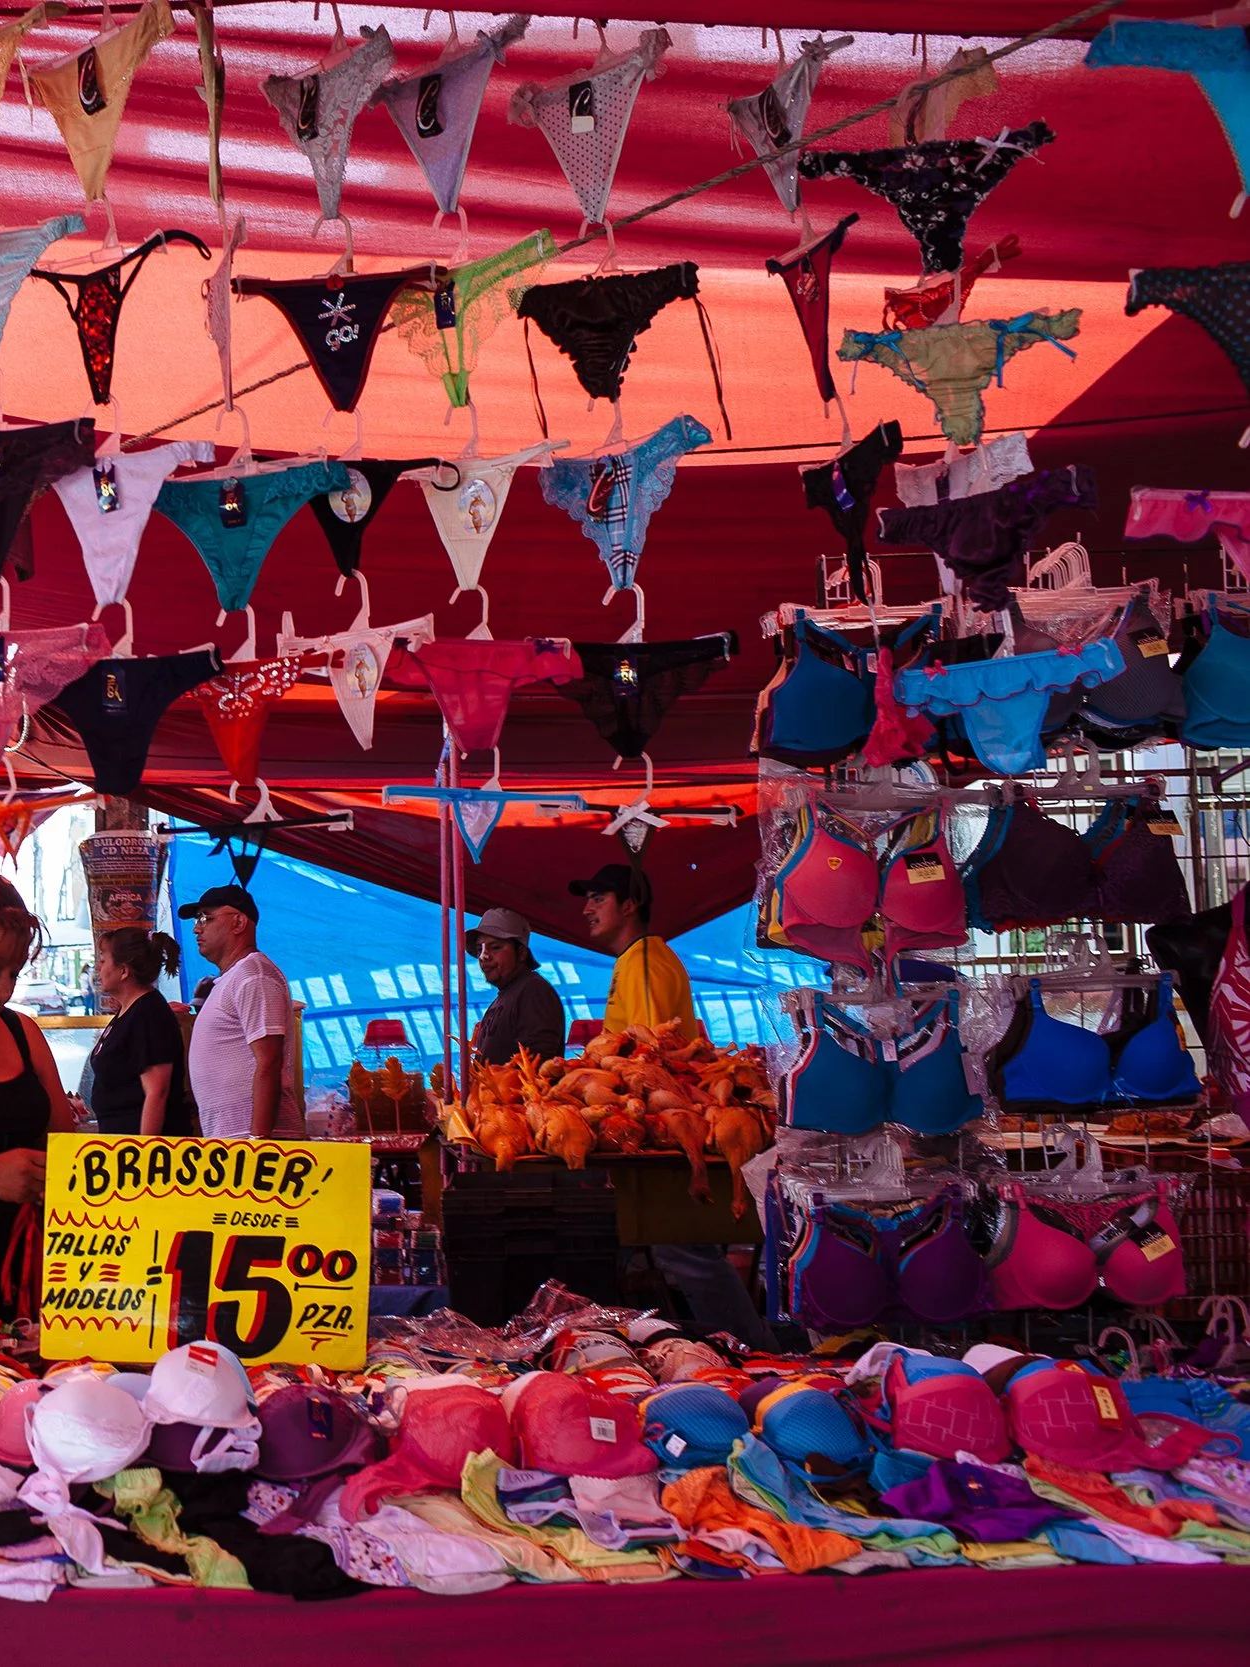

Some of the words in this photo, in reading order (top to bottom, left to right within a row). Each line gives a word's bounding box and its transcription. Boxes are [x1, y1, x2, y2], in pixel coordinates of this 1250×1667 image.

[120, 847, 150, 856] NEZA
[109, 893, 143, 902] AFRICA
[68, 1145, 333, 1198] ¡BRASSIER!
[230, 1211, 282, 1228] DESDE
[47, 1232, 132, 1256] TALLAS
[42, 1288, 146, 1311] MODELOS
[296, 1303, 354, 1330] PZA.
